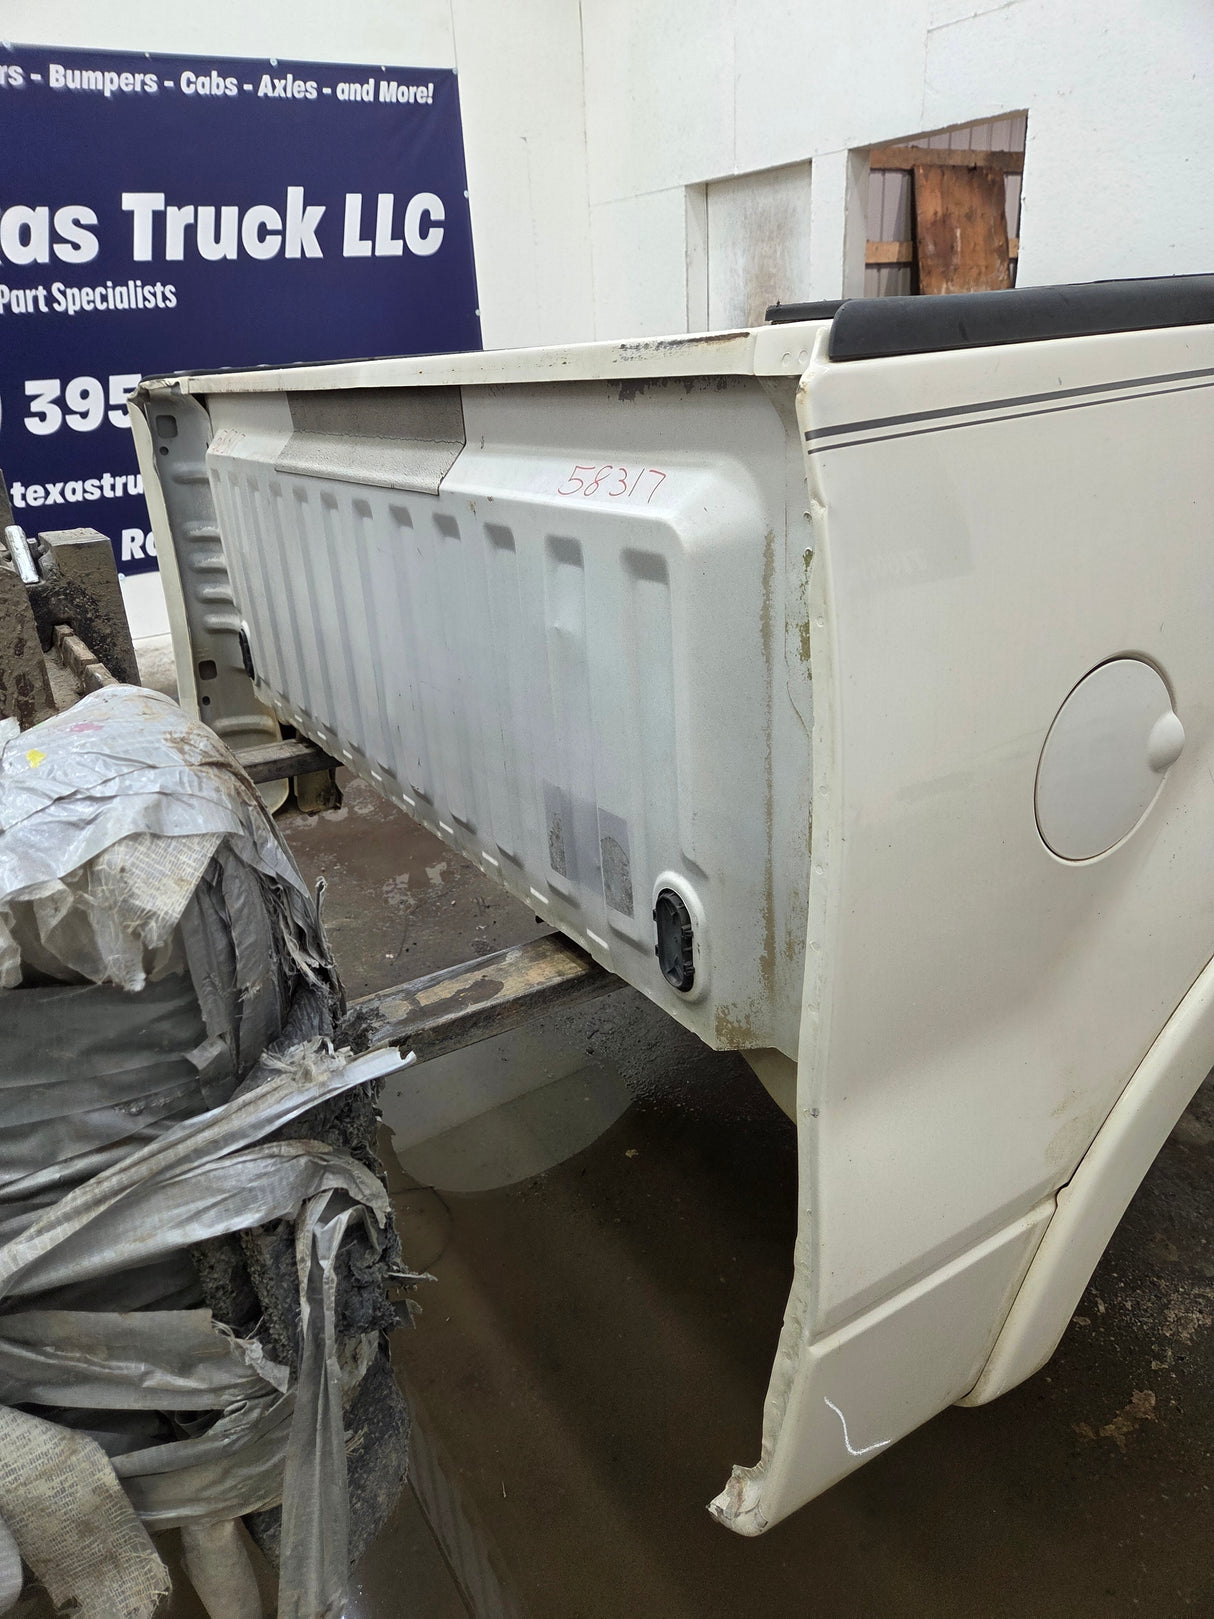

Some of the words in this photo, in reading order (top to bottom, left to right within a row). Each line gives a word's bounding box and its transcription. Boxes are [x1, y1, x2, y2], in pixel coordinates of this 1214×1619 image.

[49, 64, 158, 97] Bumpers
[180, 71, 238, 96] Cabs
[258, 74, 318, 99] Axles
[337, 79, 374, 101] and
[379, 81, 434, 104] More!
[0, 205, 99, 265] as
[122, 186, 327, 261] Truck
[343, 192, 446, 257] LLC
[0, 284, 49, 314] Part
[51, 280, 177, 315] Specialists
[24, 373, 142, 435] 395
[558, 465, 666, 503] 58317
